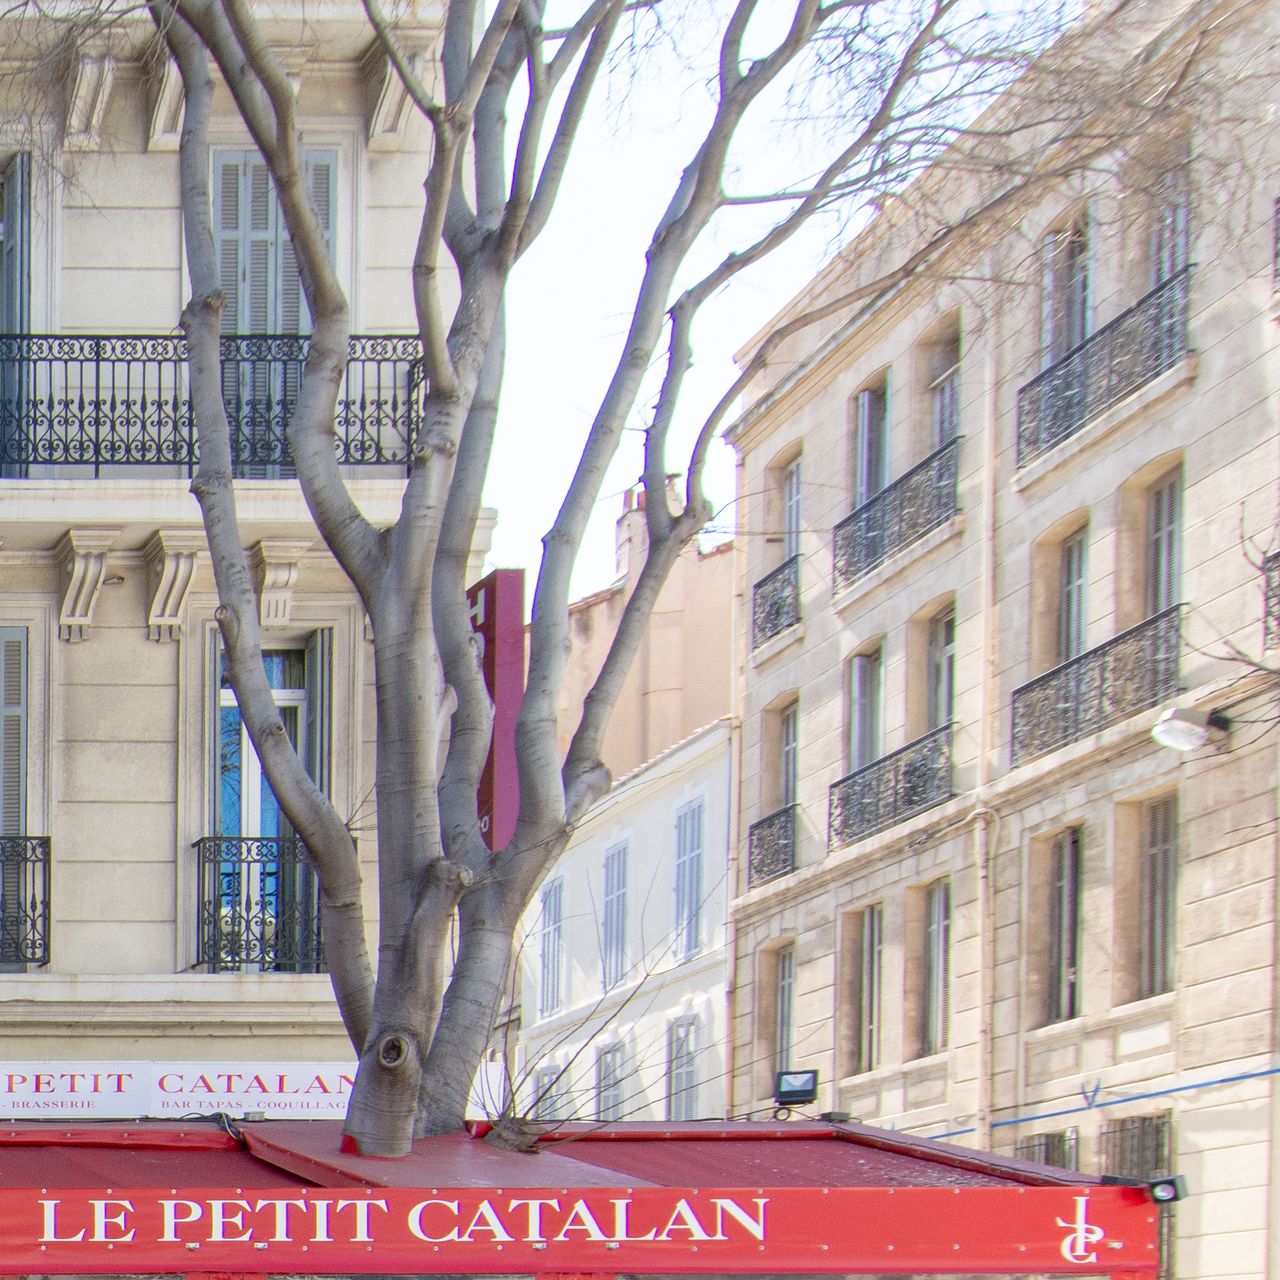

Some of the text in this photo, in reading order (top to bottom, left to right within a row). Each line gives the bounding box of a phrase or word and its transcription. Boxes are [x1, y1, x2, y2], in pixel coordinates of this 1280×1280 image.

[5, 1073, 134, 1094] PETIT
[12, 1101, 96, 1109] BRASSERIE
[161, 1101, 191, 1109] BAR
[197, 1101, 242, 1109] TAPAS
[257, 1101, 346, 1110] COQUILLAG
[38, 1198, 770, 1243] LE PETIT CATALAN
